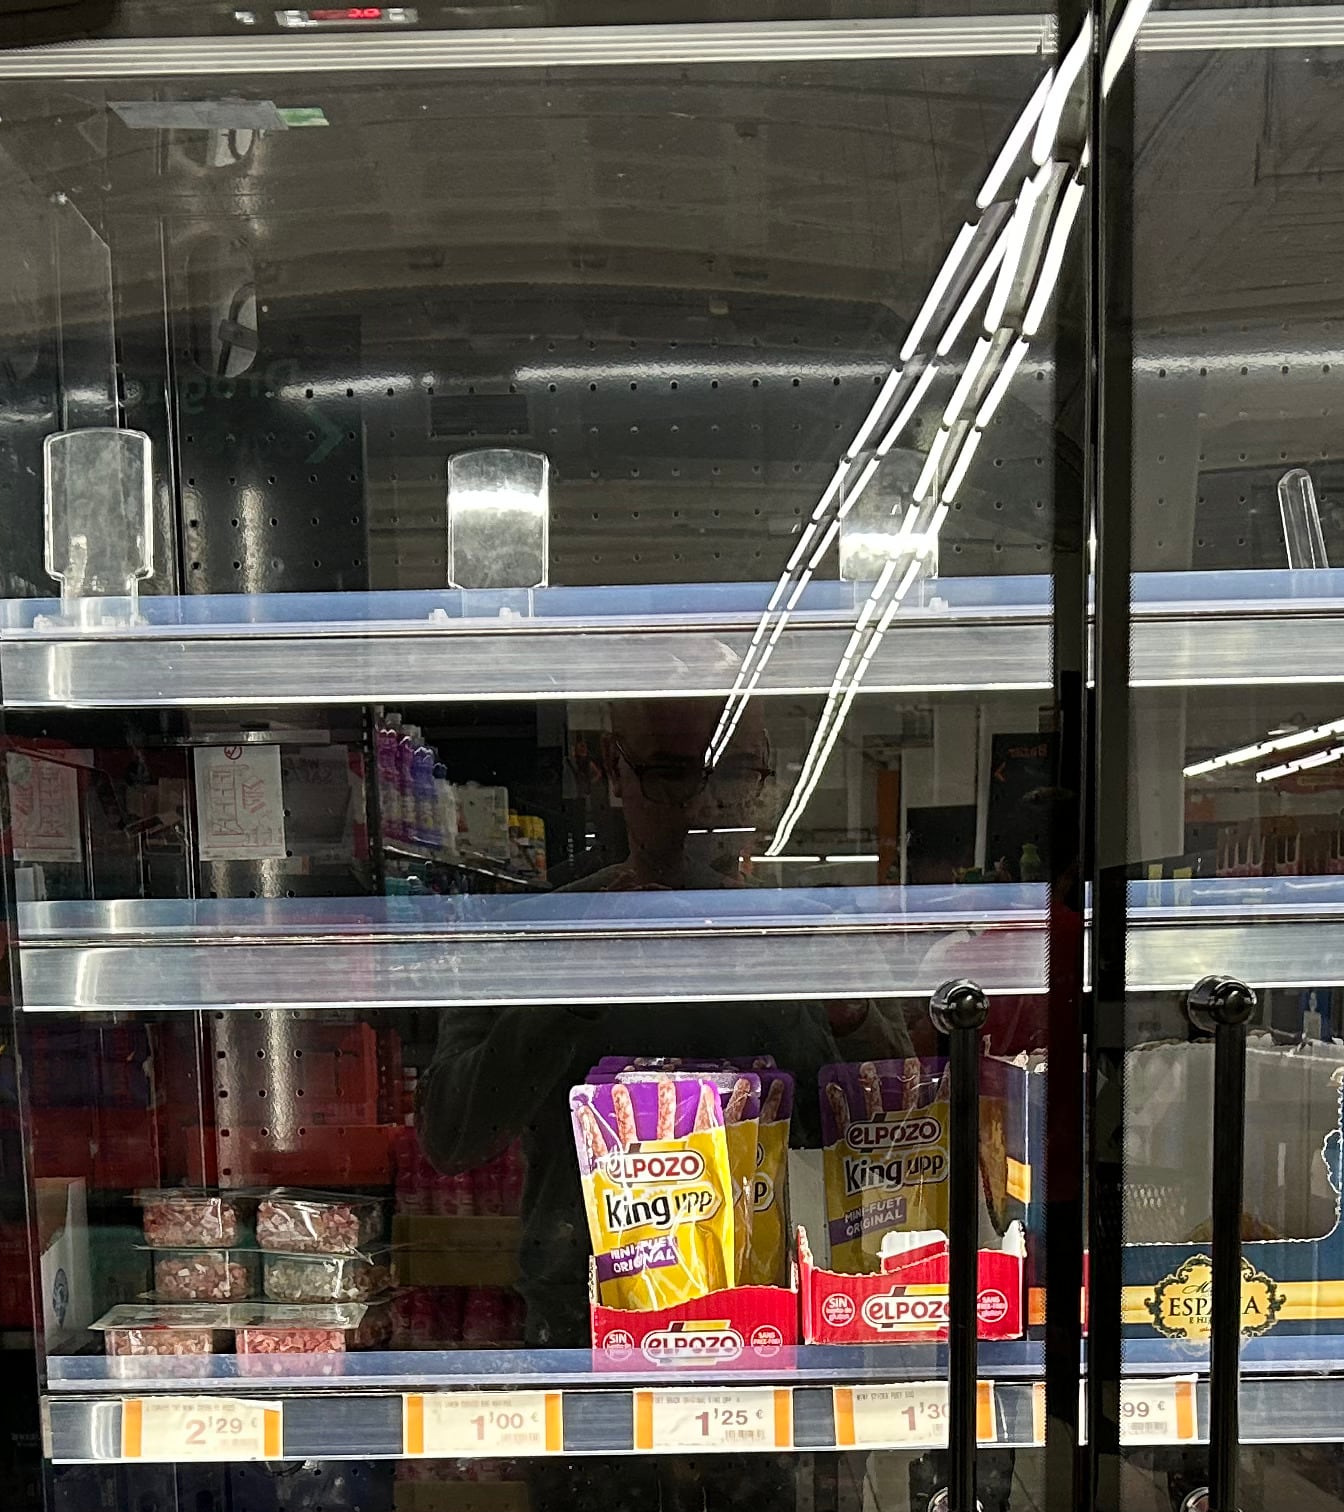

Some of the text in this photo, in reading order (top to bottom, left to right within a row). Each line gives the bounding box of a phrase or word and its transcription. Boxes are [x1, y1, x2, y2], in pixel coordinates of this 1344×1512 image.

[830, 1299, 848, 1308] SIN
[1168, 1296, 1262, 1317] ESPA
[608, 1334, 627, 1344] SIN
